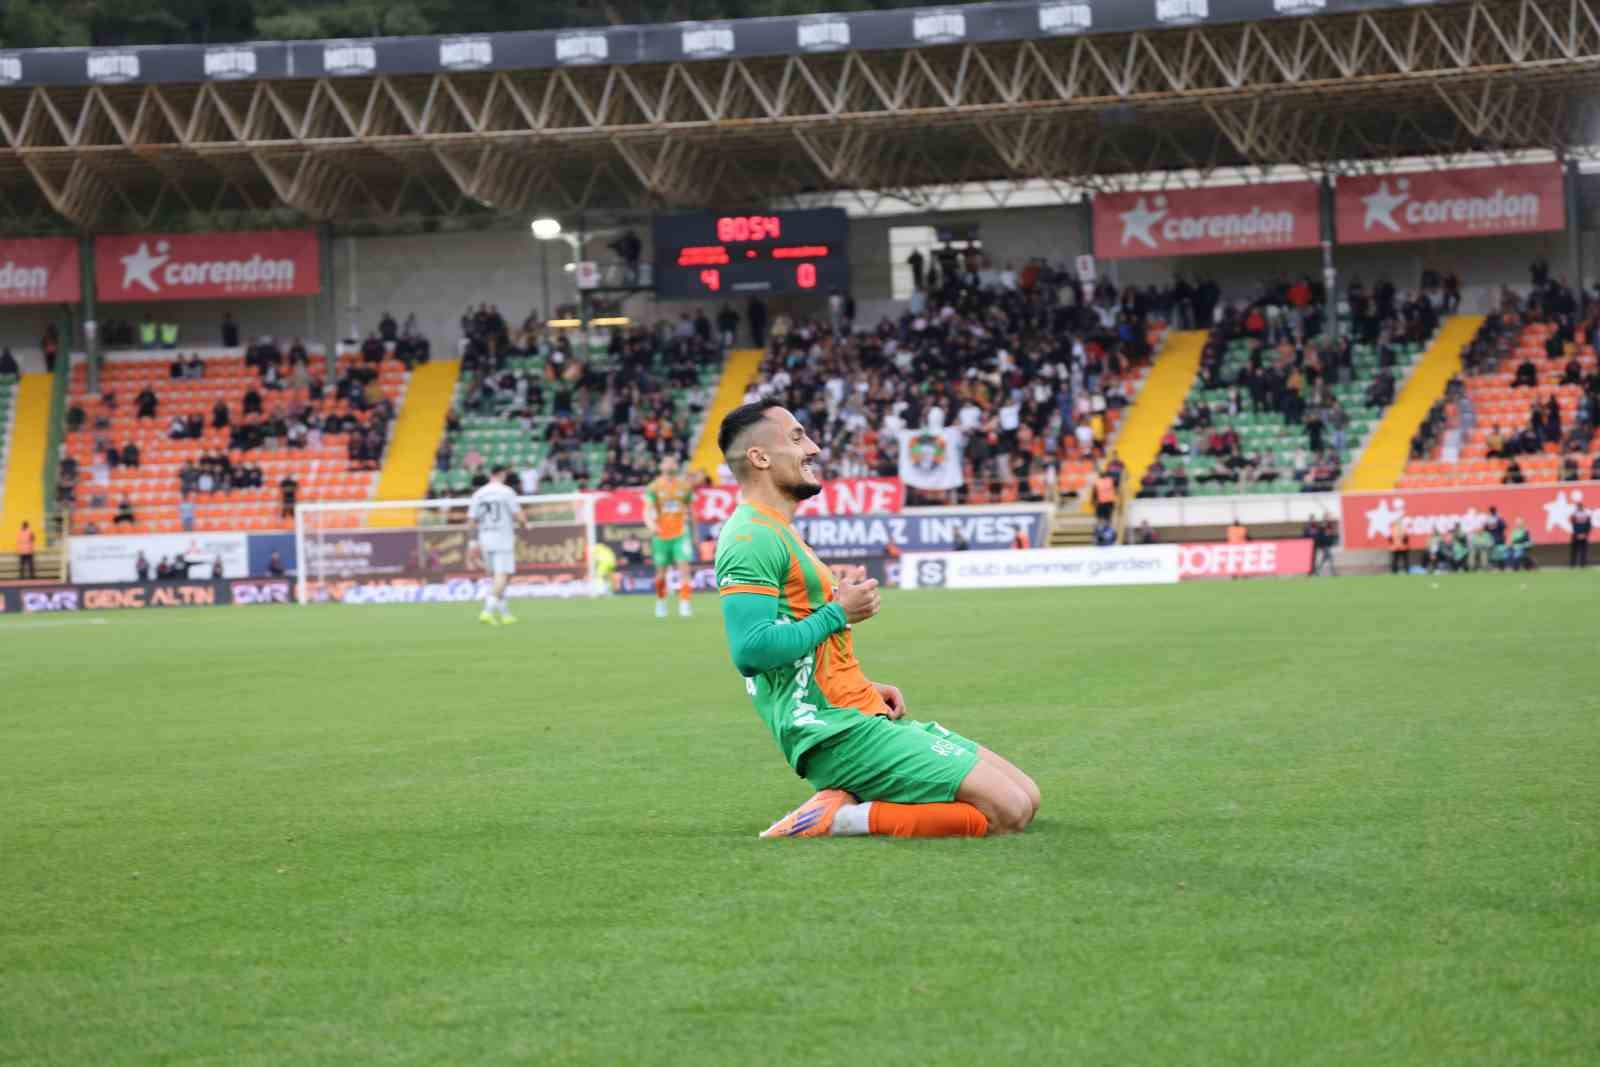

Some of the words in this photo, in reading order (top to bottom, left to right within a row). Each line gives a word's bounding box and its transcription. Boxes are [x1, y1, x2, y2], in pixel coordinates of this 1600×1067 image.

[1406, 189, 1539, 224] corendon
[1162, 207, 1295, 241] corendon
[164, 253, 295, 286] corendon
[700, 269, 720, 291] 4
[796, 262, 817, 289] 0
[920, 515, 1036, 544] INVEST
[1005, 558, 1084, 576] summer
[1089, 554, 1162, 577] garden
[1178, 543, 1278, 575] OFFEE
